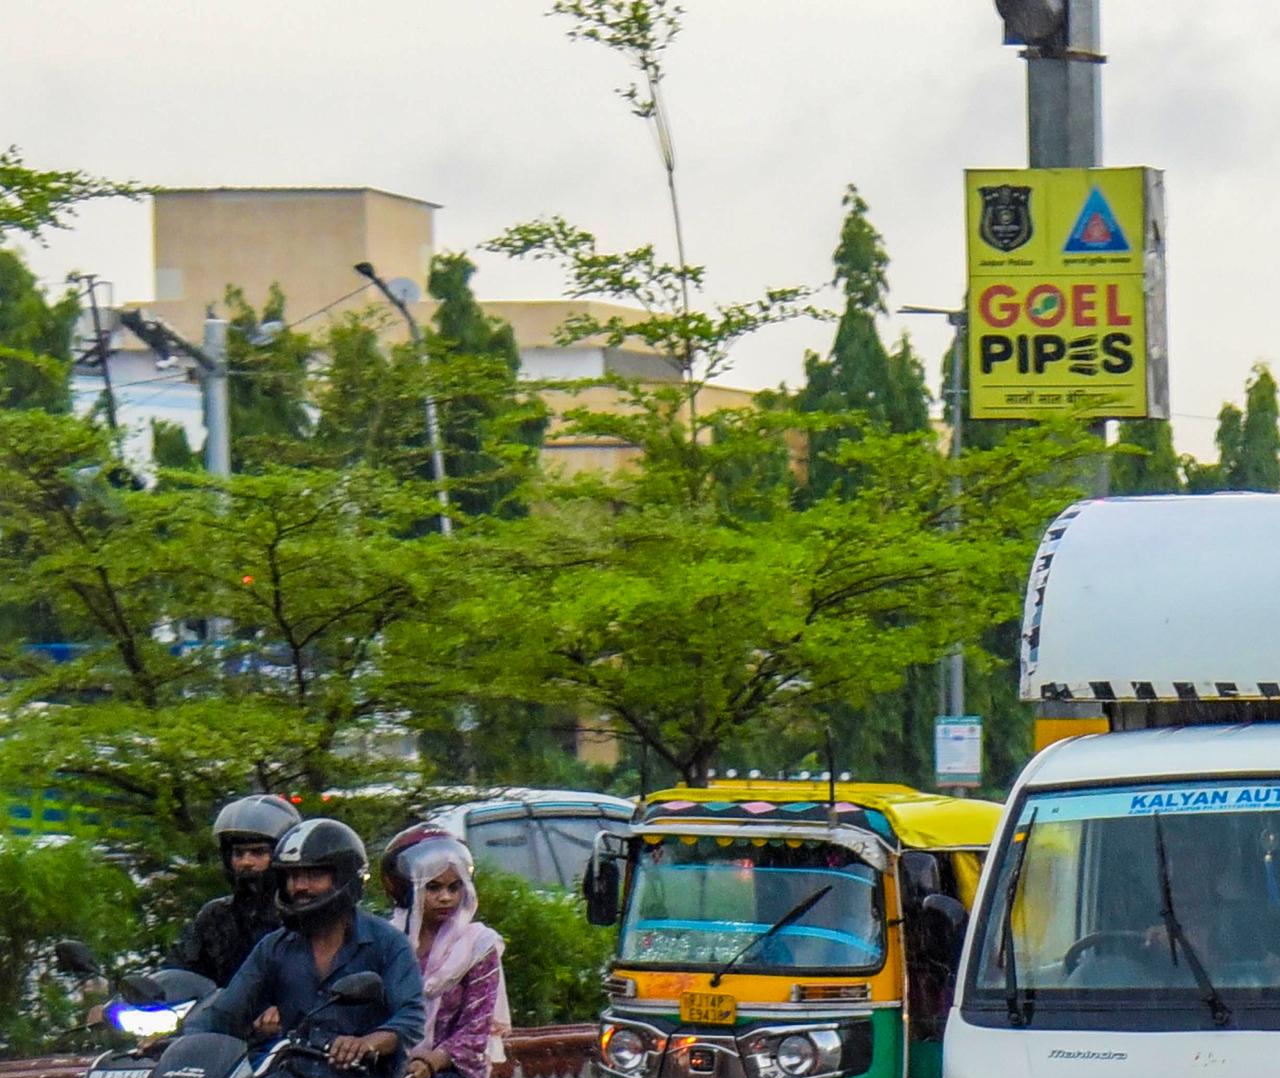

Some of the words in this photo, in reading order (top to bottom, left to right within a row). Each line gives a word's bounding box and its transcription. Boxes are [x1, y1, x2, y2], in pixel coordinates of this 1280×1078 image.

[979, 284, 1132, 328] GOEL
[980, 333, 1134, 376] PIPES
[1131, 791, 1228, 809] KALYAN
